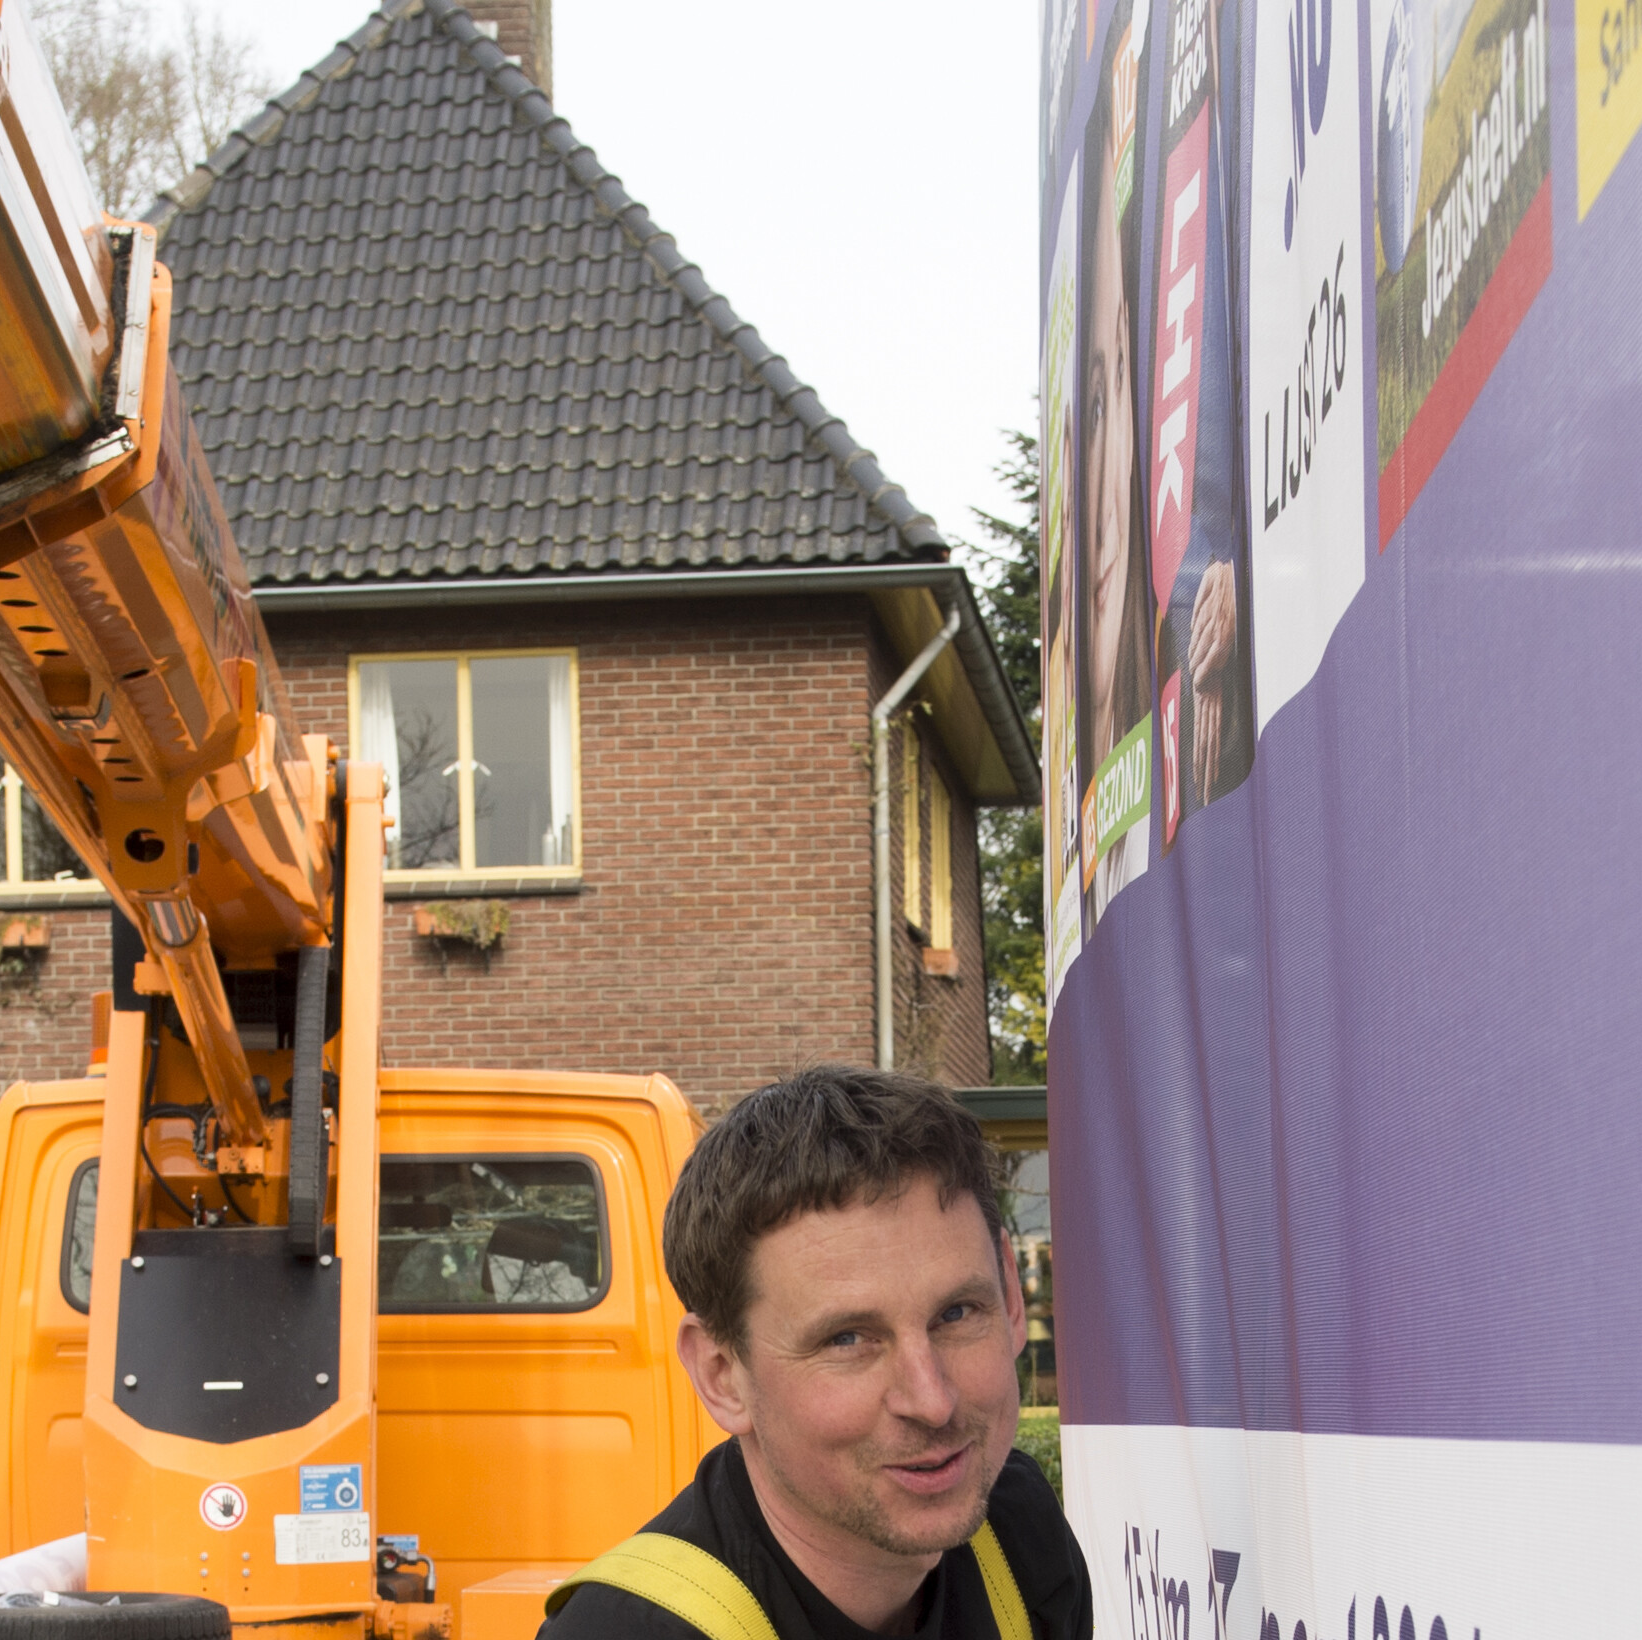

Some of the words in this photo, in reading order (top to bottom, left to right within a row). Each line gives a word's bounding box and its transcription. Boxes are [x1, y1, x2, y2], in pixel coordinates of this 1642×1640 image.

[1168, 19, 1208, 128] KROL
[1173, 0, 1207, 66] HEN
[1264, 302, 1316, 533] LIJST
[1320, 239, 1347, 425] 26
[1096, 737, 1147, 844] GEZOND
[341, 1528, 362, 1548] 83
